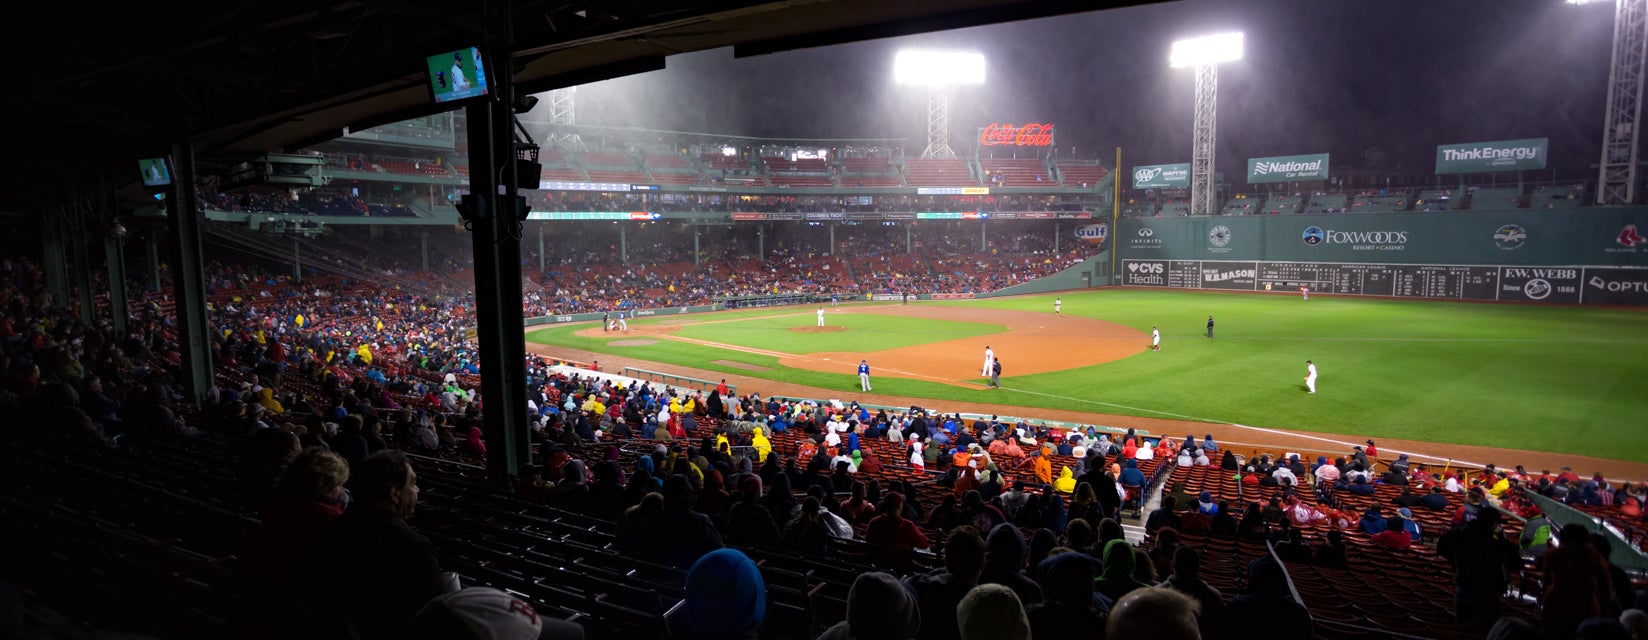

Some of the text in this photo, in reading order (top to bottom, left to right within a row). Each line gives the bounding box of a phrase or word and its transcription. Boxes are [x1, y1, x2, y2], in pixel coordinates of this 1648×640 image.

[1268, 159, 1321, 173] National
[1076, 227, 1106, 236] Gulf
[1326, 230, 1407, 243] FOXWOODS
[1139, 263, 1164, 273] CVS
[1129, 273, 1164, 285] Health
[1533, 269, 1577, 279] WEBB
